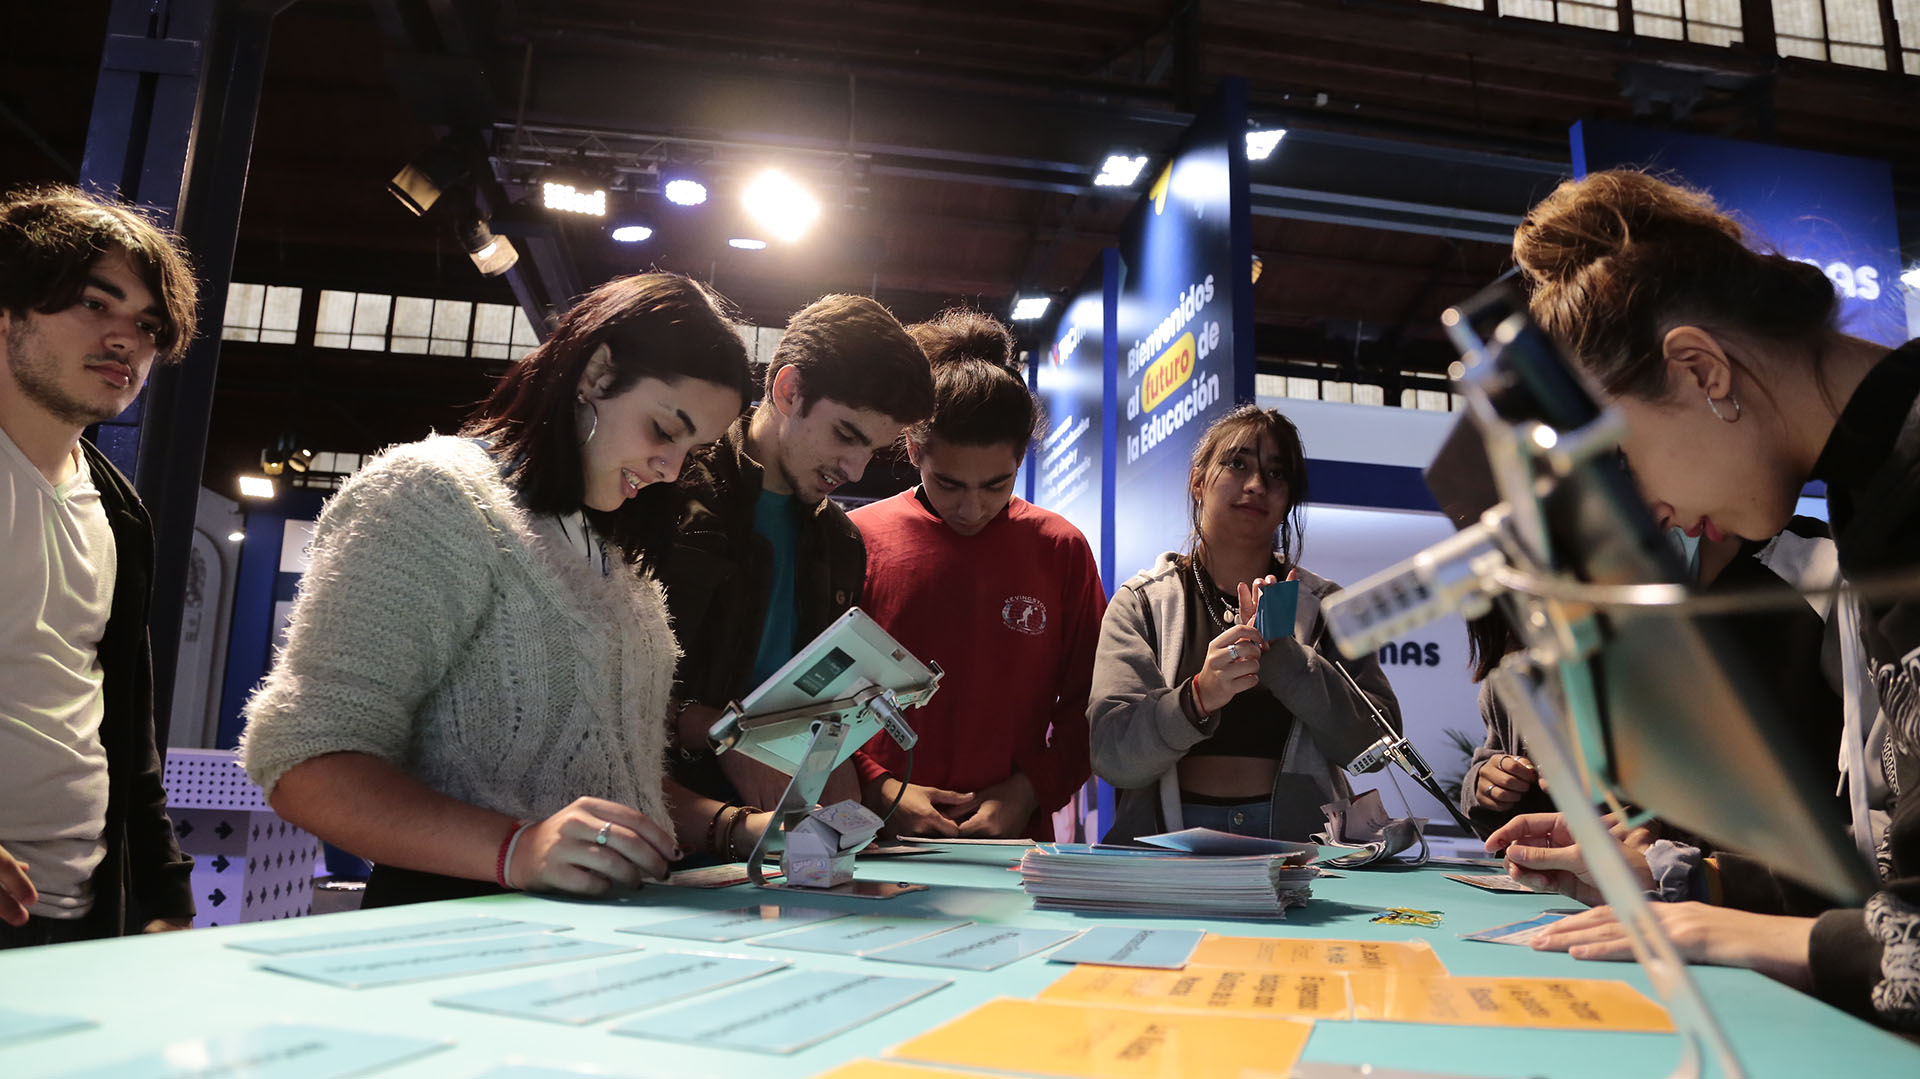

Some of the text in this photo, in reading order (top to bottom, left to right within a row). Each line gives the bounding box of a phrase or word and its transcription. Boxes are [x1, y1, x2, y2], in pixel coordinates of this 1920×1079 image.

[1127, 274, 1215, 376] Bienvenidos
[1127, 321, 1220, 421] al futuro de
[1127, 435, 1140, 465] la
[1141, 371, 1220, 455] Educación
